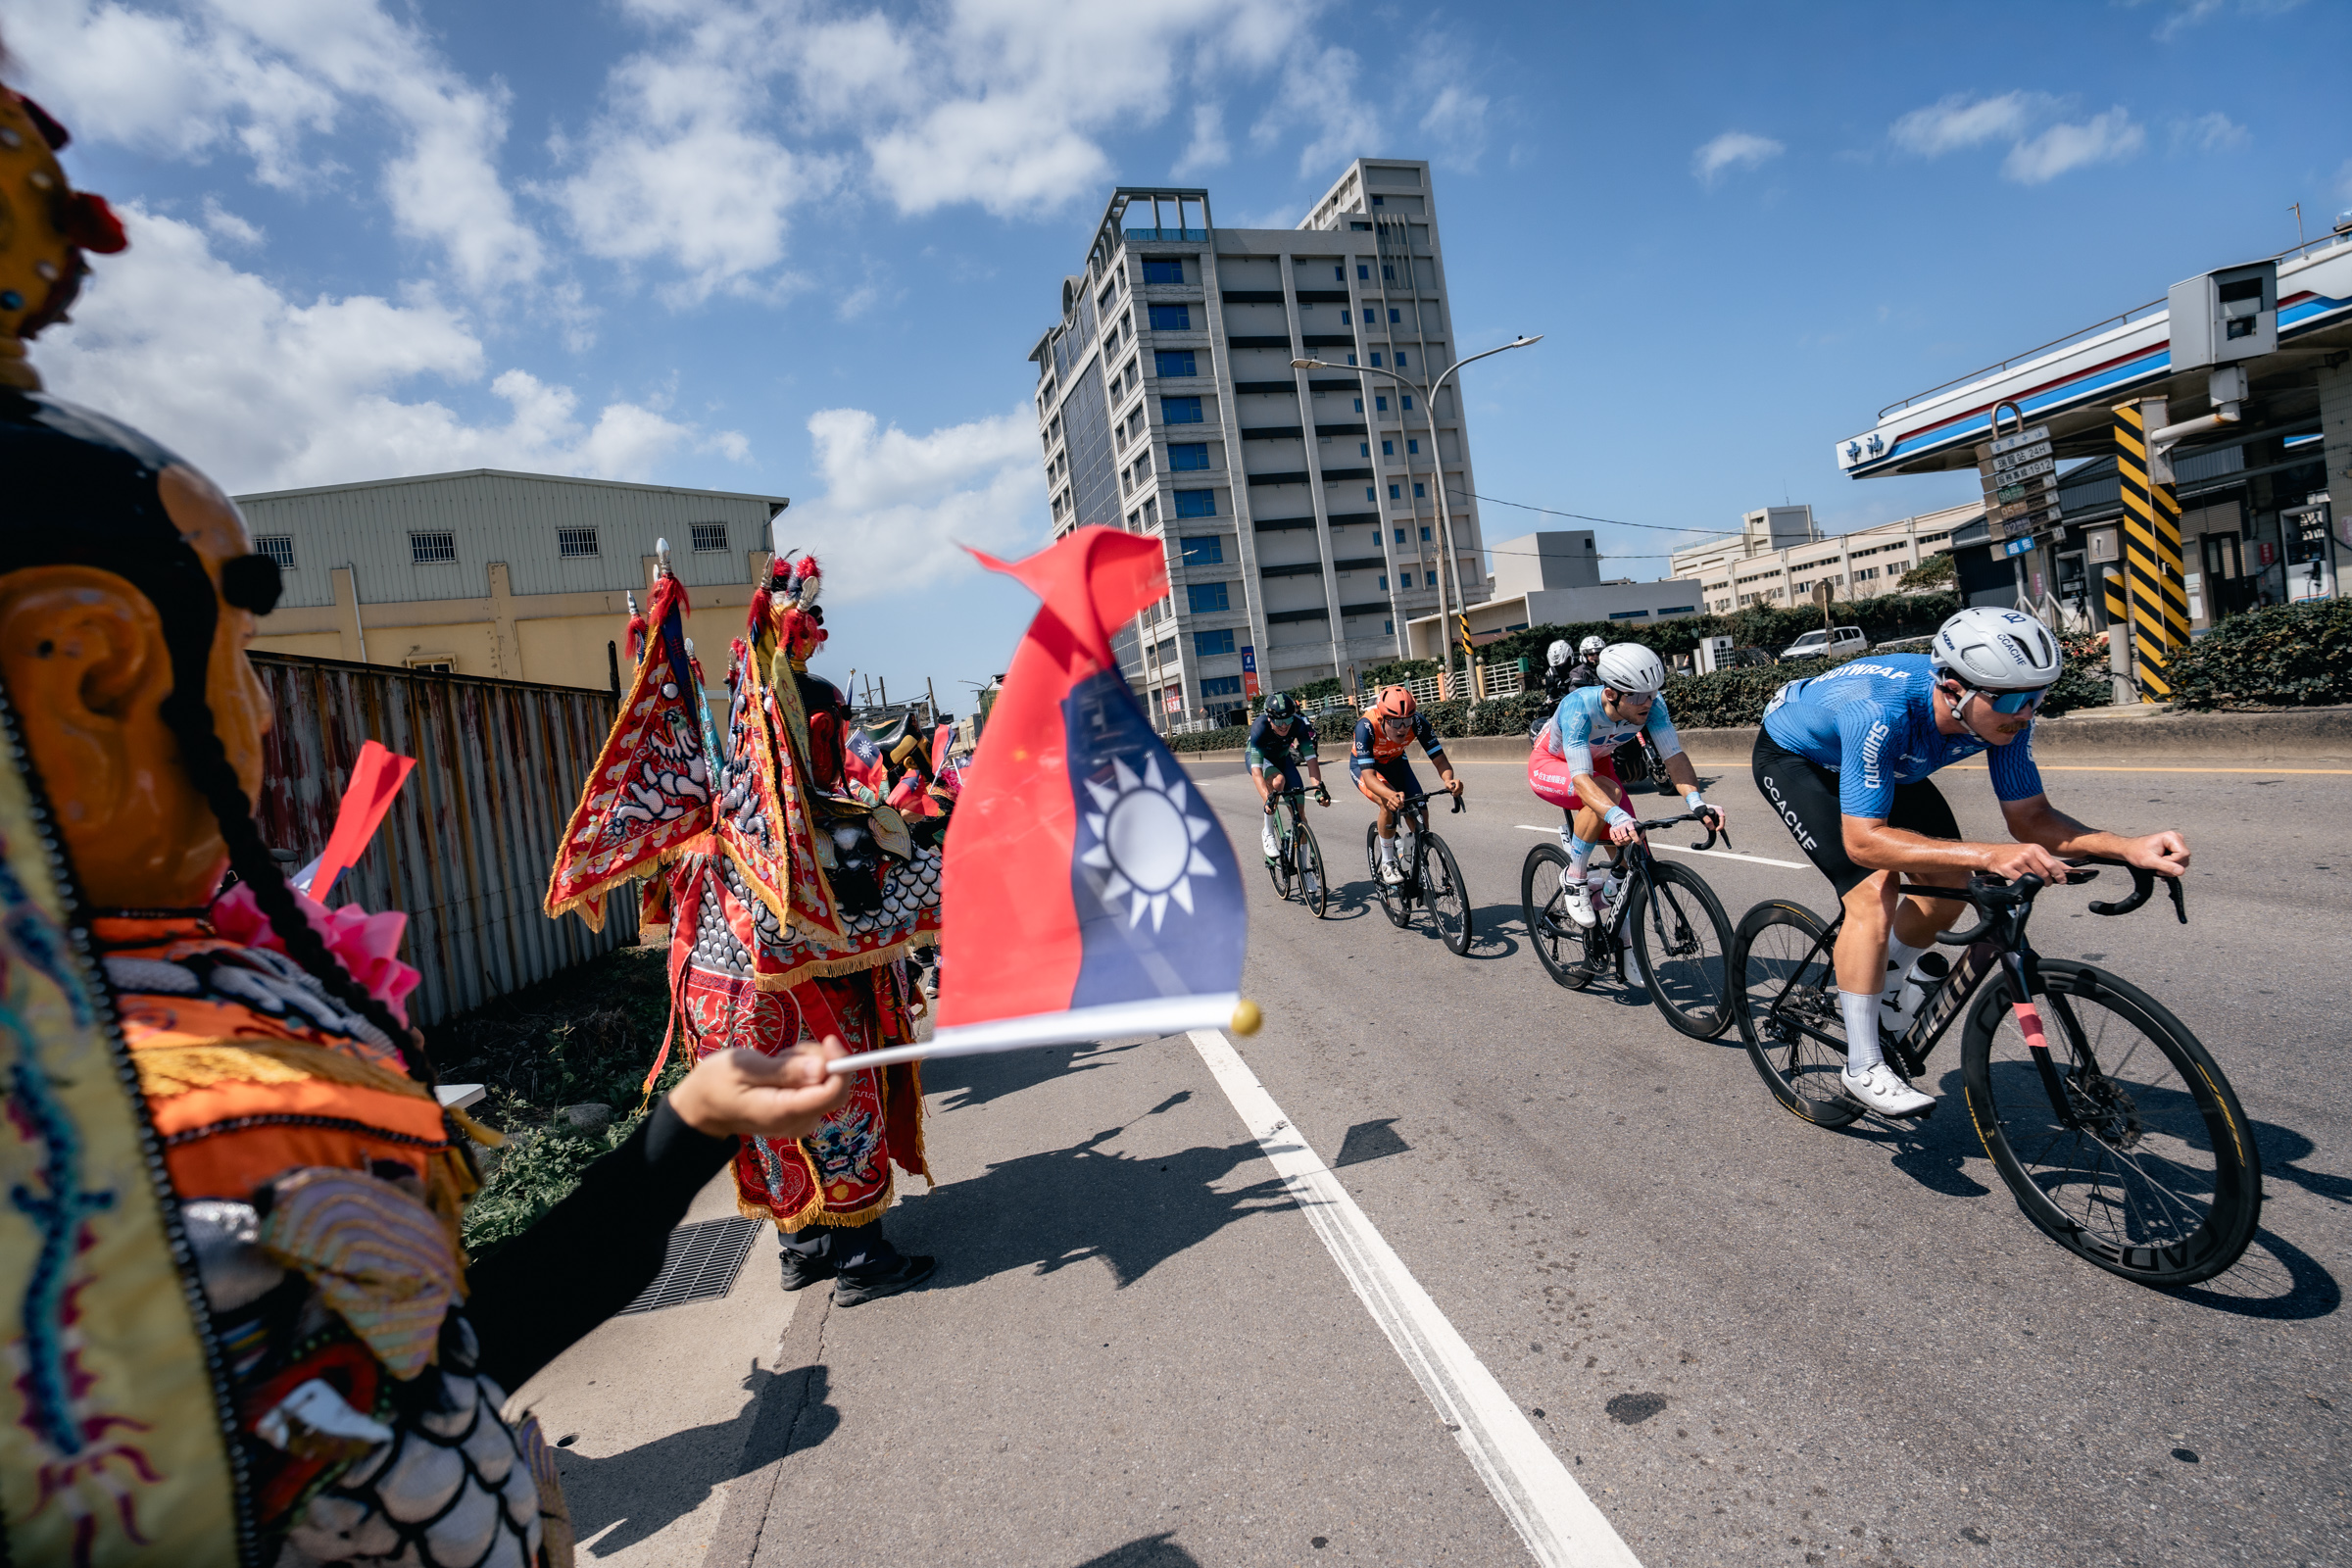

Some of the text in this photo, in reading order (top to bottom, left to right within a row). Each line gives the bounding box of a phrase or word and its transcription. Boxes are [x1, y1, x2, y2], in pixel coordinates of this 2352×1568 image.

[1847, 434, 1884, 463] 中油
[2028, 445, 2046, 458] 24H
[1999, 490, 2012, 503] 98
[2001, 505, 2014, 518] 95
[2004, 522, 2017, 536] 92
[1941, 630, 1956, 652] LAZER
[1809, 663, 1911, 686] BODYWRAP
[1864, 720, 1889, 789] SHIMANO
[1764, 776, 1818, 851] CCACHE
[1606, 869, 1633, 934] ORBEA
[1906, 947, 1976, 1054] GIANT
[2057, 1218, 2219, 1272] CADEX
